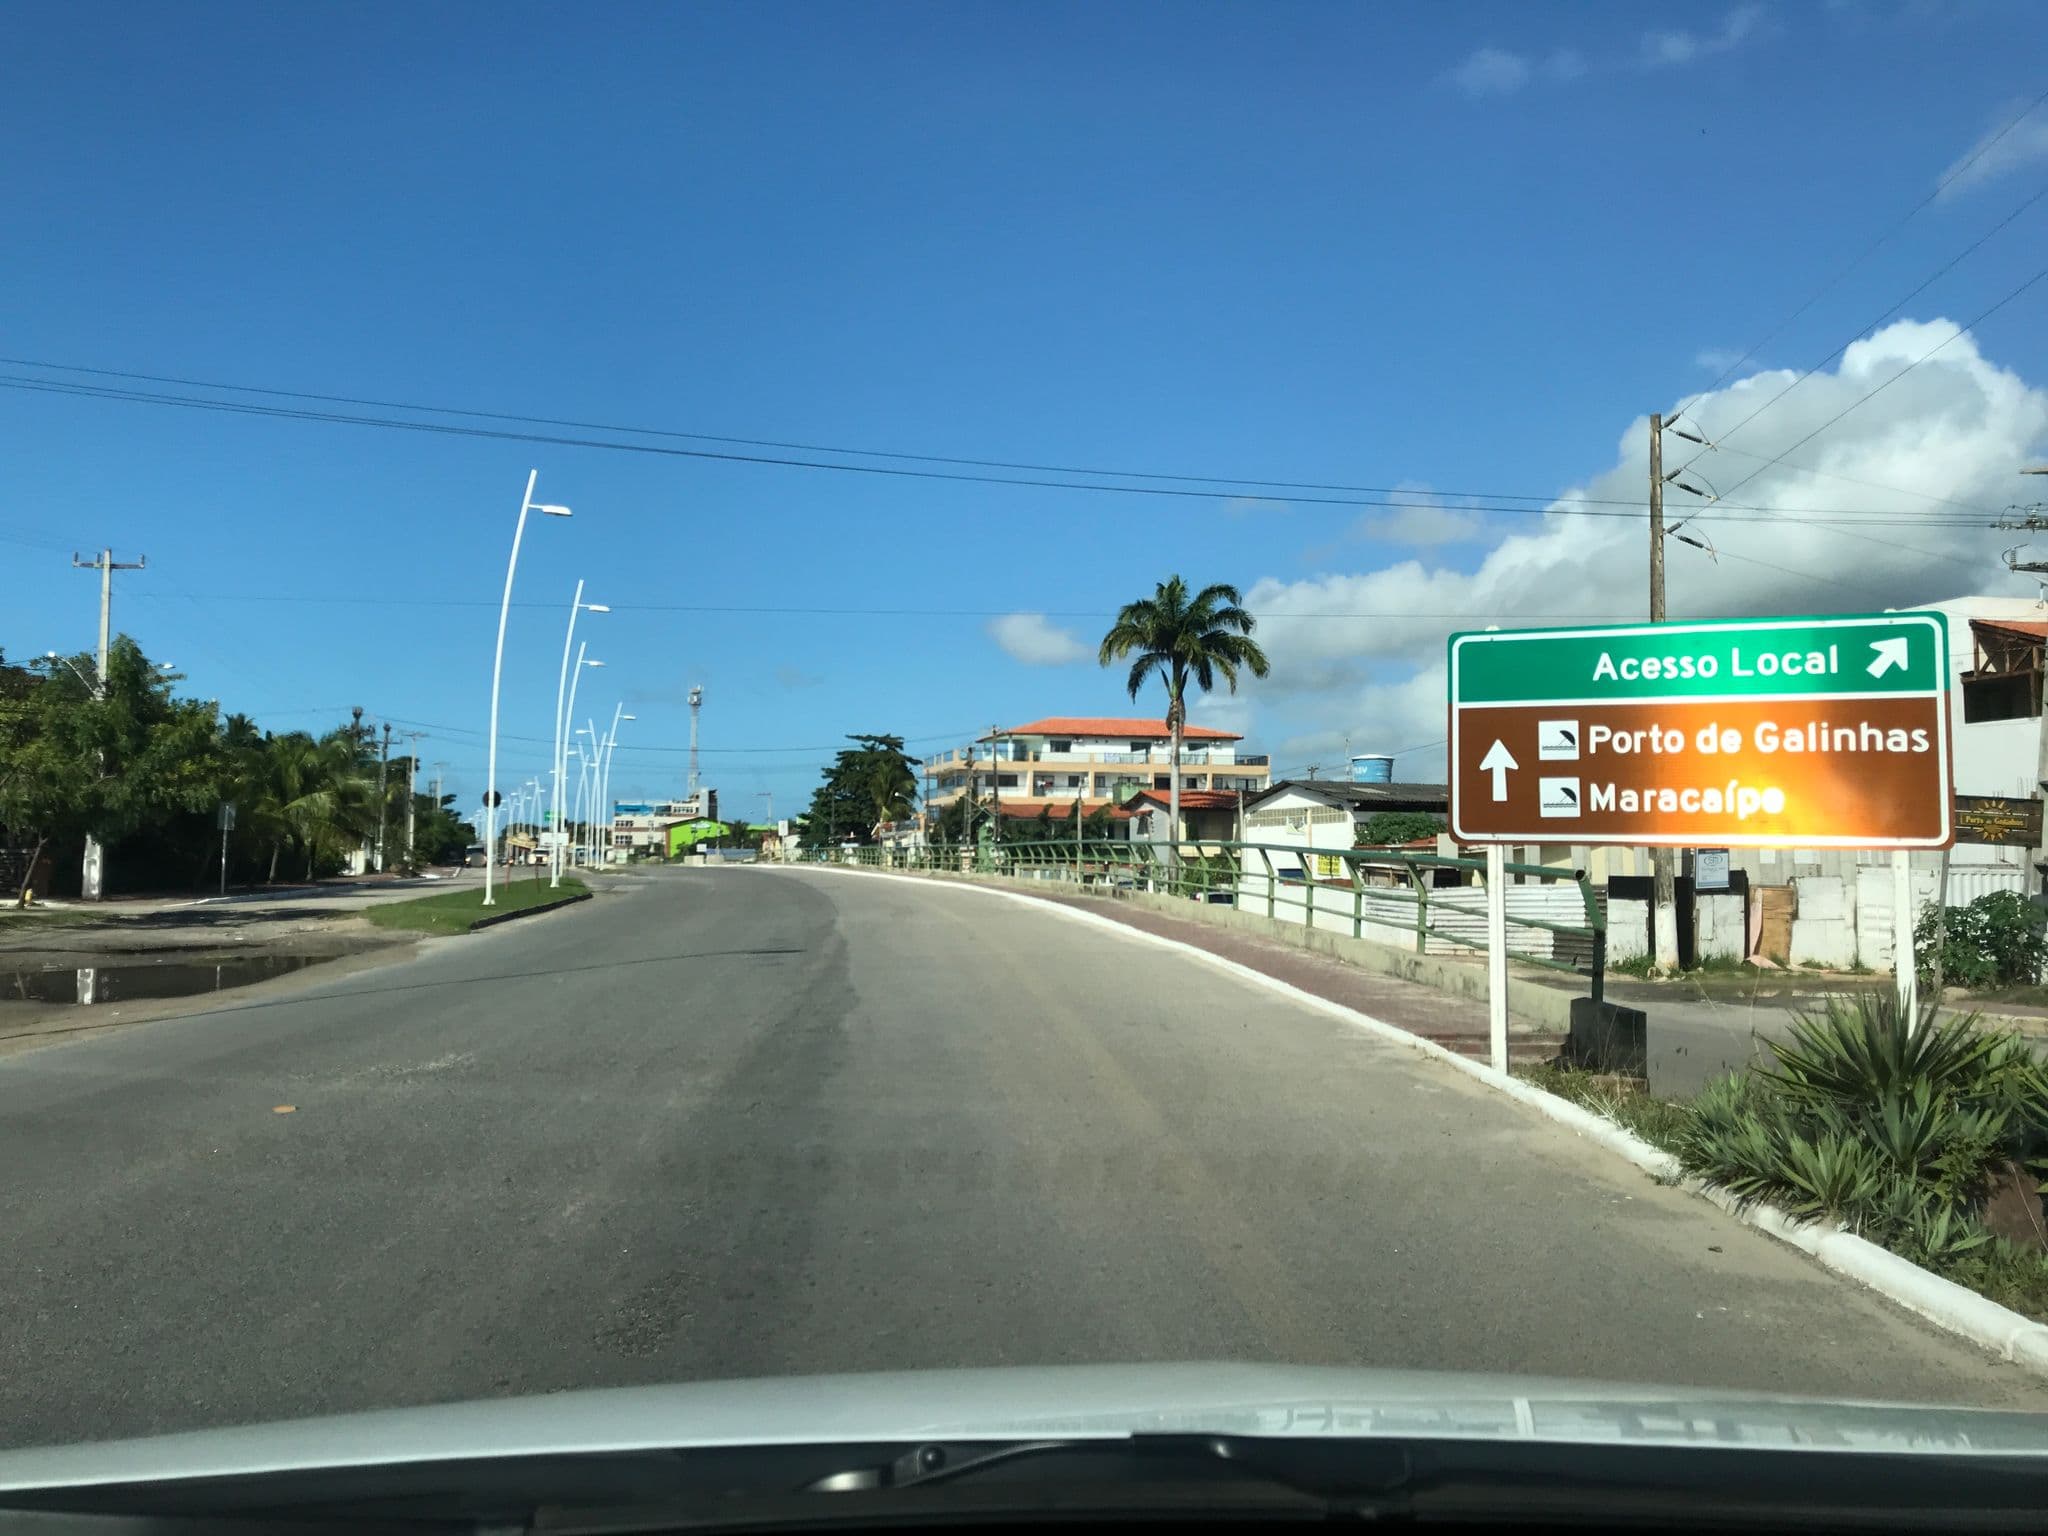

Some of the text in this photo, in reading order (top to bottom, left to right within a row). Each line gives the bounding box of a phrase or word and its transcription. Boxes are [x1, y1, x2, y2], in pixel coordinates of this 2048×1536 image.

[1592, 644, 1839, 682] Acesso Local
[1588, 721, 1931, 755] Porto de Galinhas
[1589, 779, 1786, 821] Maracaípe
